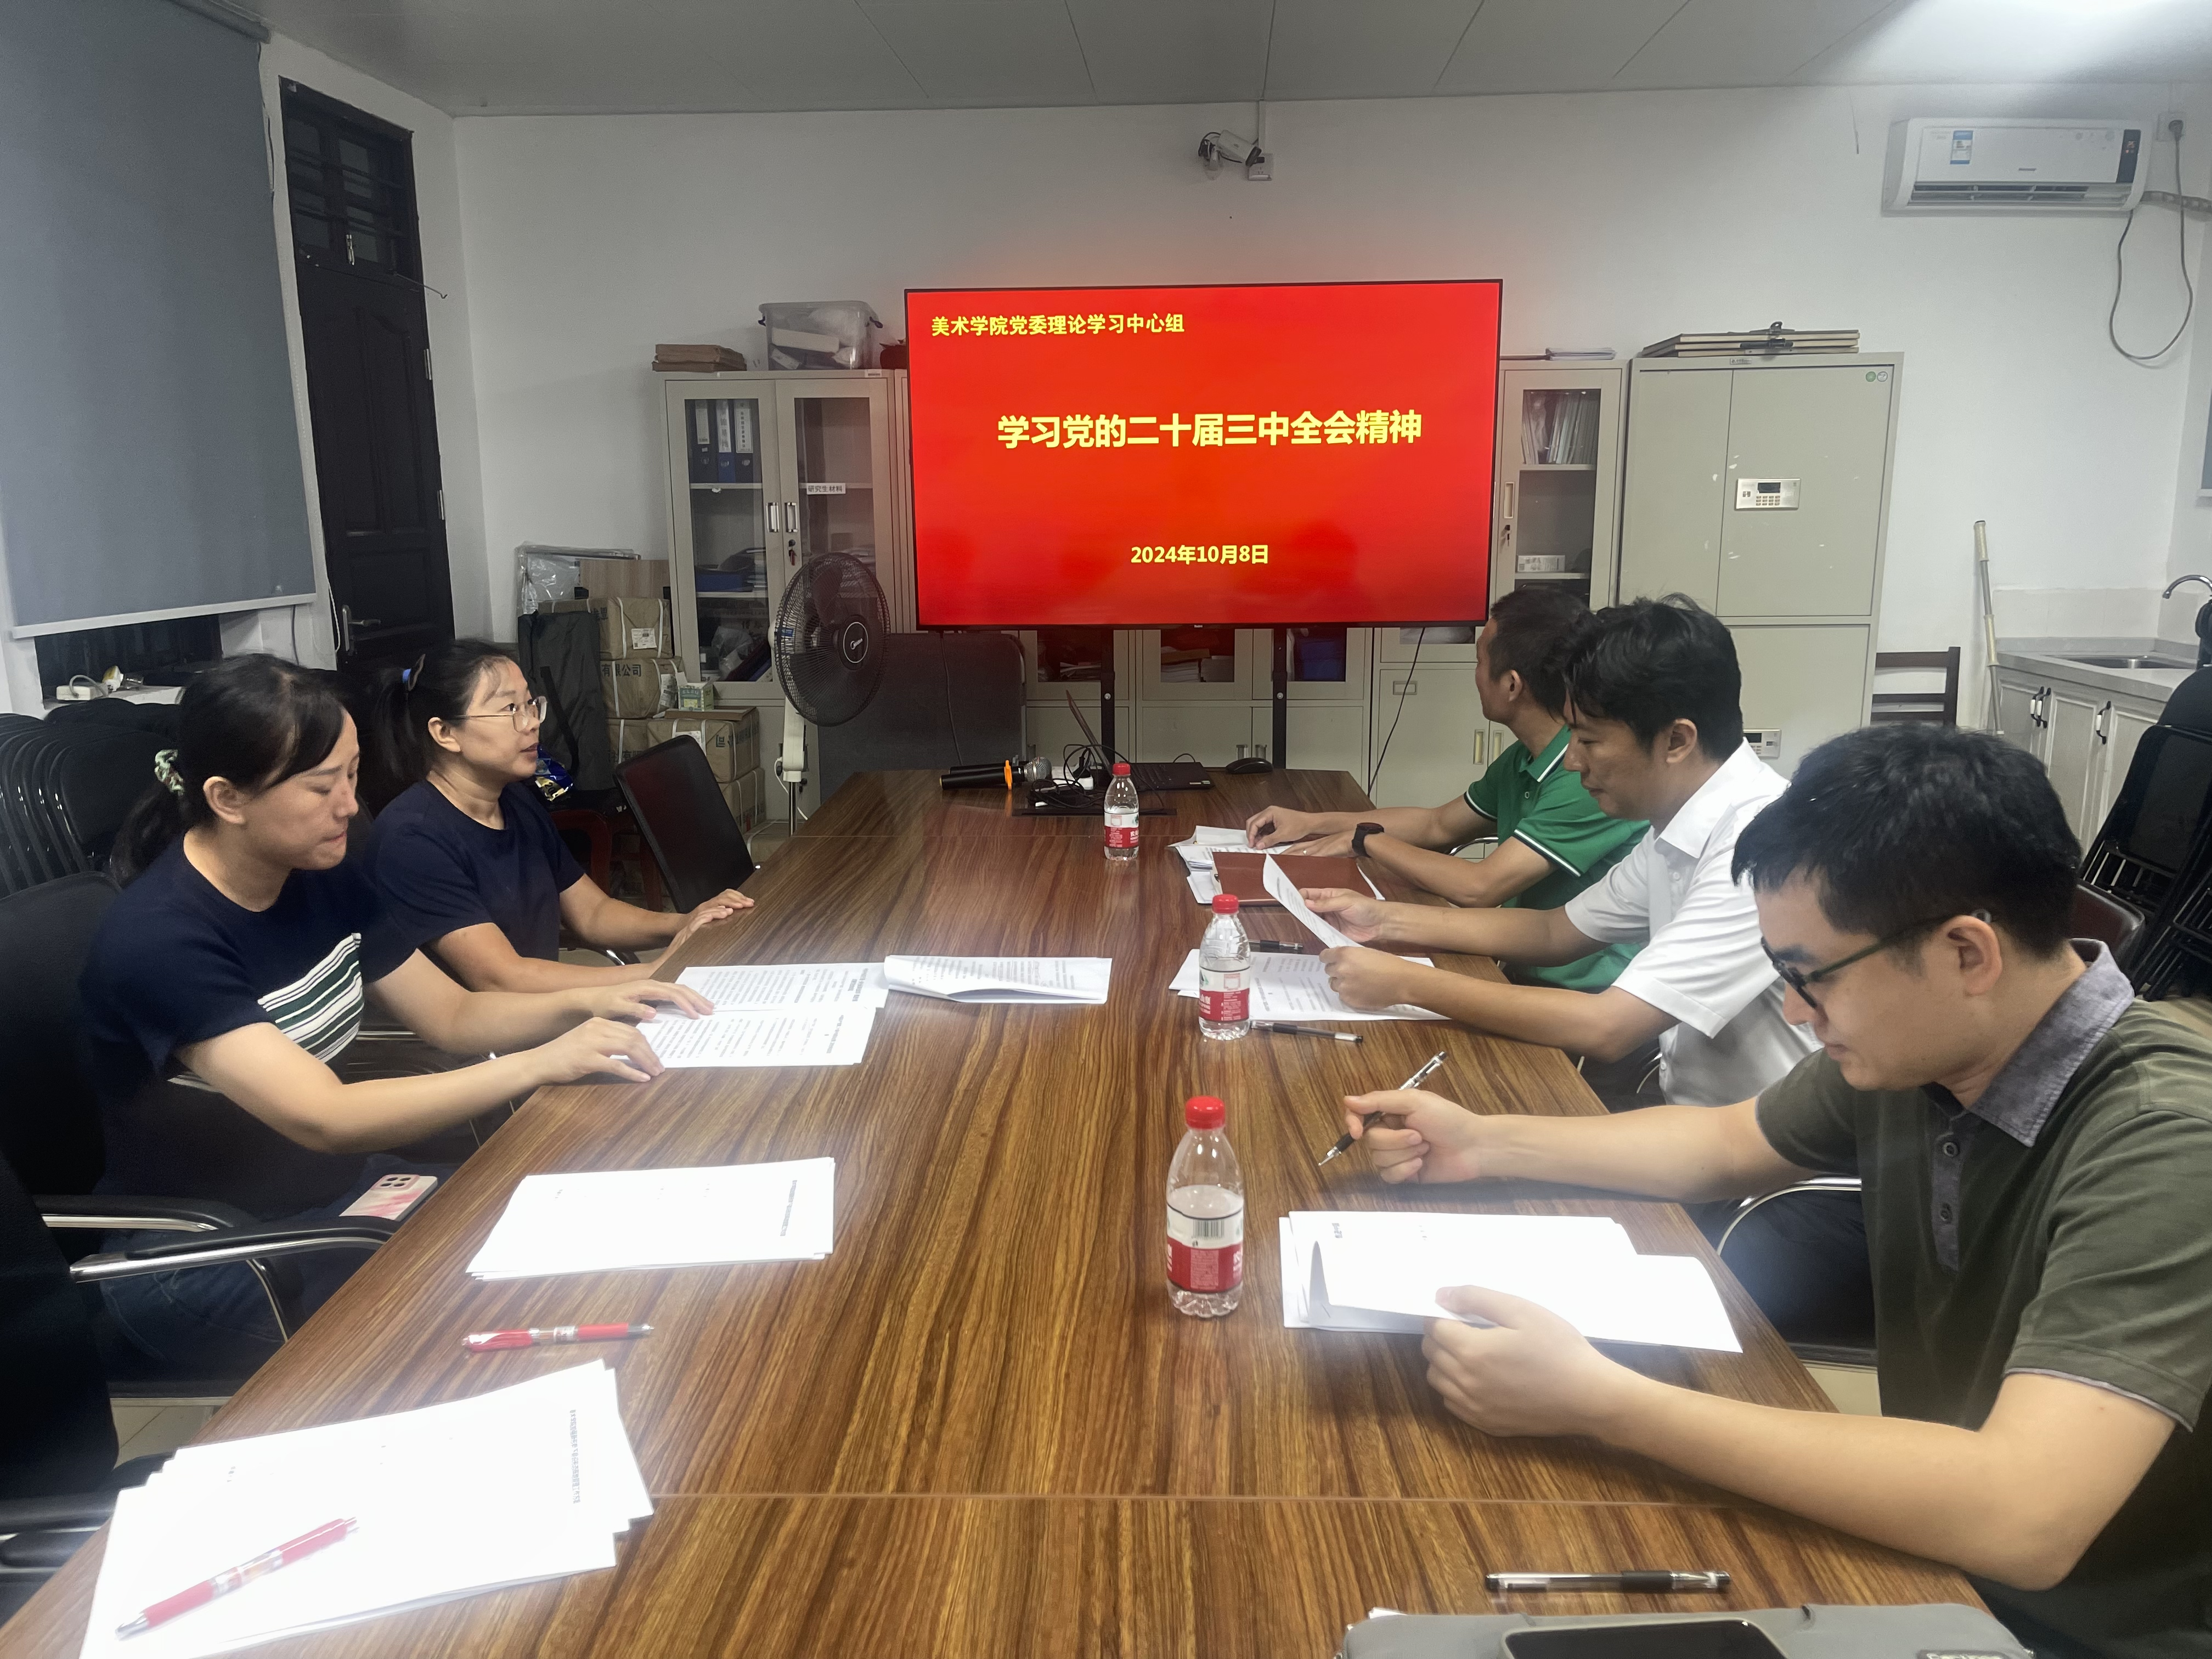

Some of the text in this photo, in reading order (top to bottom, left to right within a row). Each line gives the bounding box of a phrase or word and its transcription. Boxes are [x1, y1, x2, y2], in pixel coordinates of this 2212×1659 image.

[931, 313, 1184, 336] 美术学院党委理论学习中心组
[997, 409, 1422, 449] 学习党的二十届三中全会精神
[1130, 544, 1268, 565] 2024年10月8日
